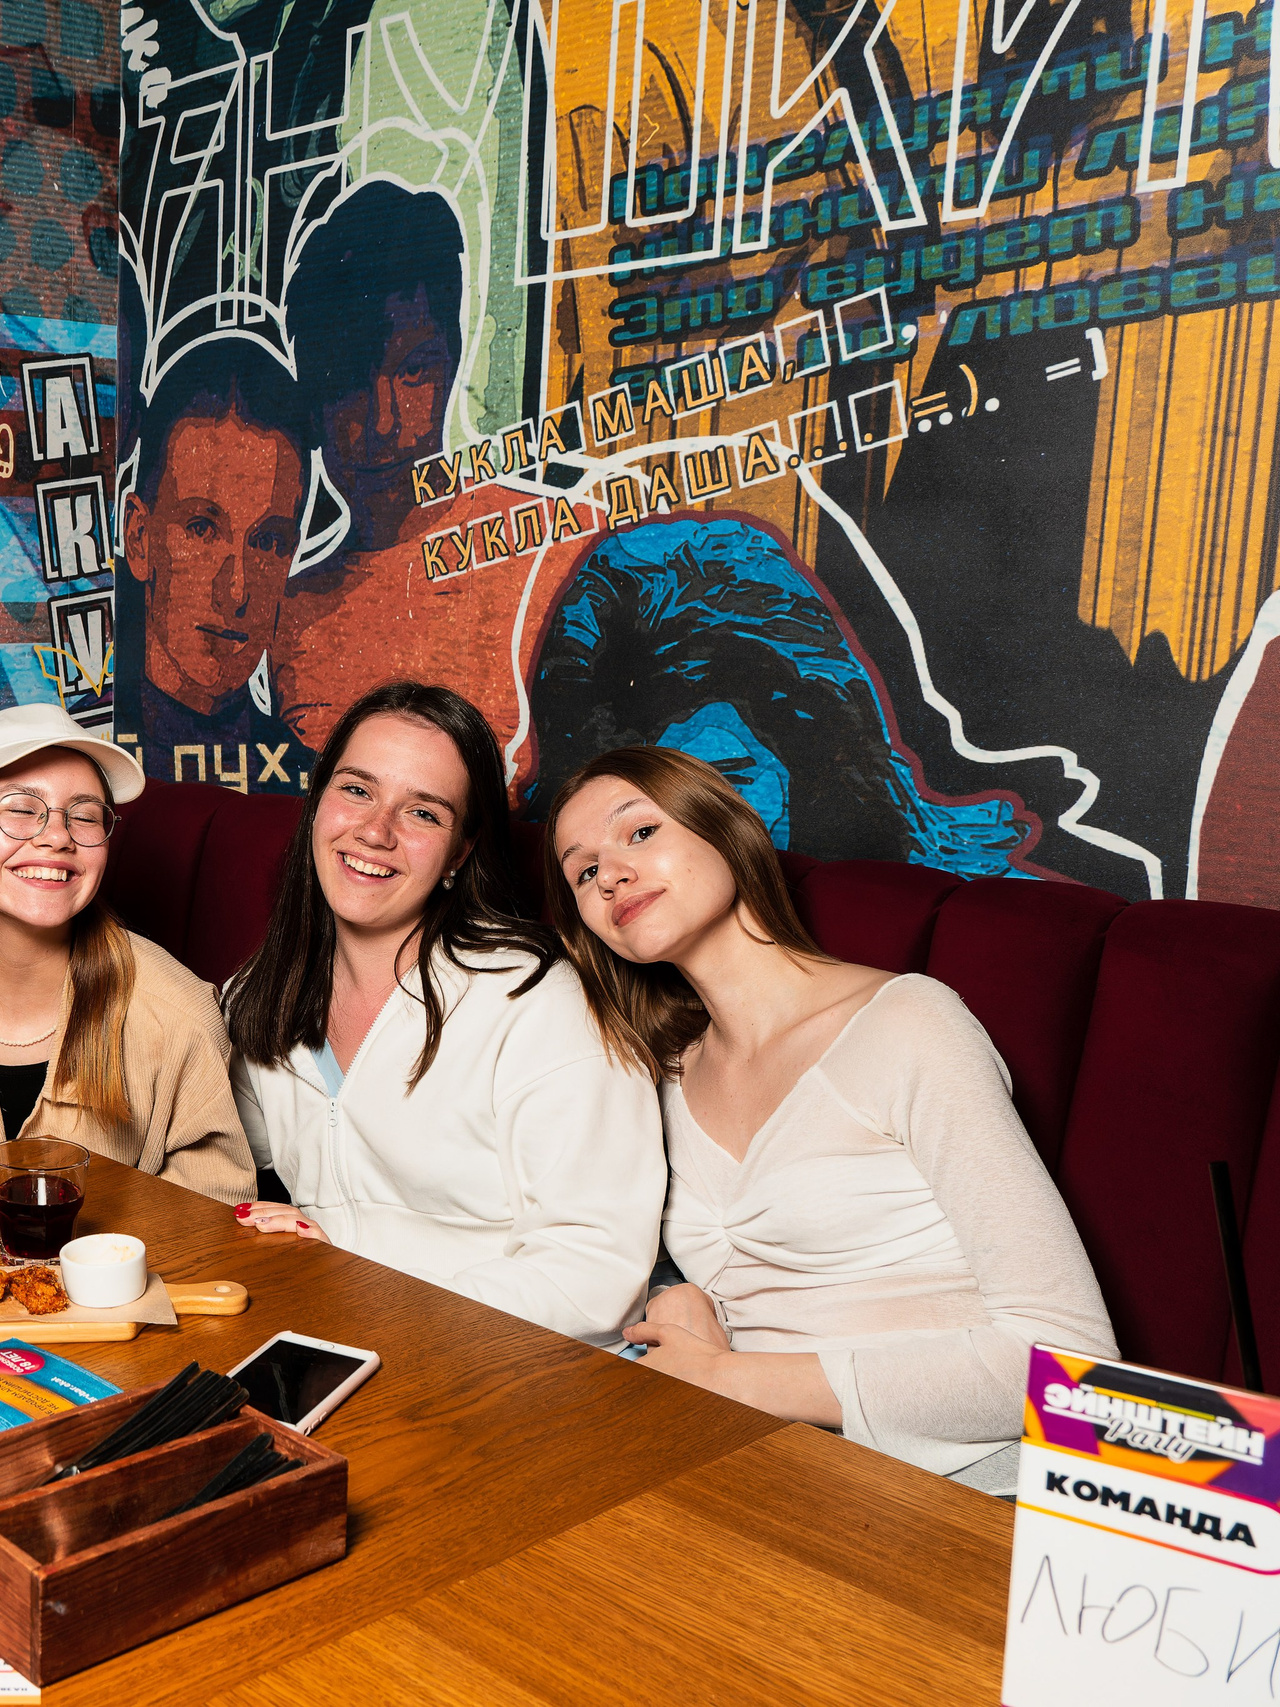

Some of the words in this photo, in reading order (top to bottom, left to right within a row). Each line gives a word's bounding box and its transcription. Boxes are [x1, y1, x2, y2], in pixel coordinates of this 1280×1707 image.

[410, 416, 568, 506] КУКЛА
[422, 496, 581, 580] КУКЛА
[0, 1350, 25, 1365] ЛЕТ
[21, 1358, 37, 1371] 18
[1043, 1383, 1266, 1460] ЭЙНШТЕЙН
[1104, 1417, 1198, 1463] Party
[1045, 1470, 1258, 1549] КОМАНДА
